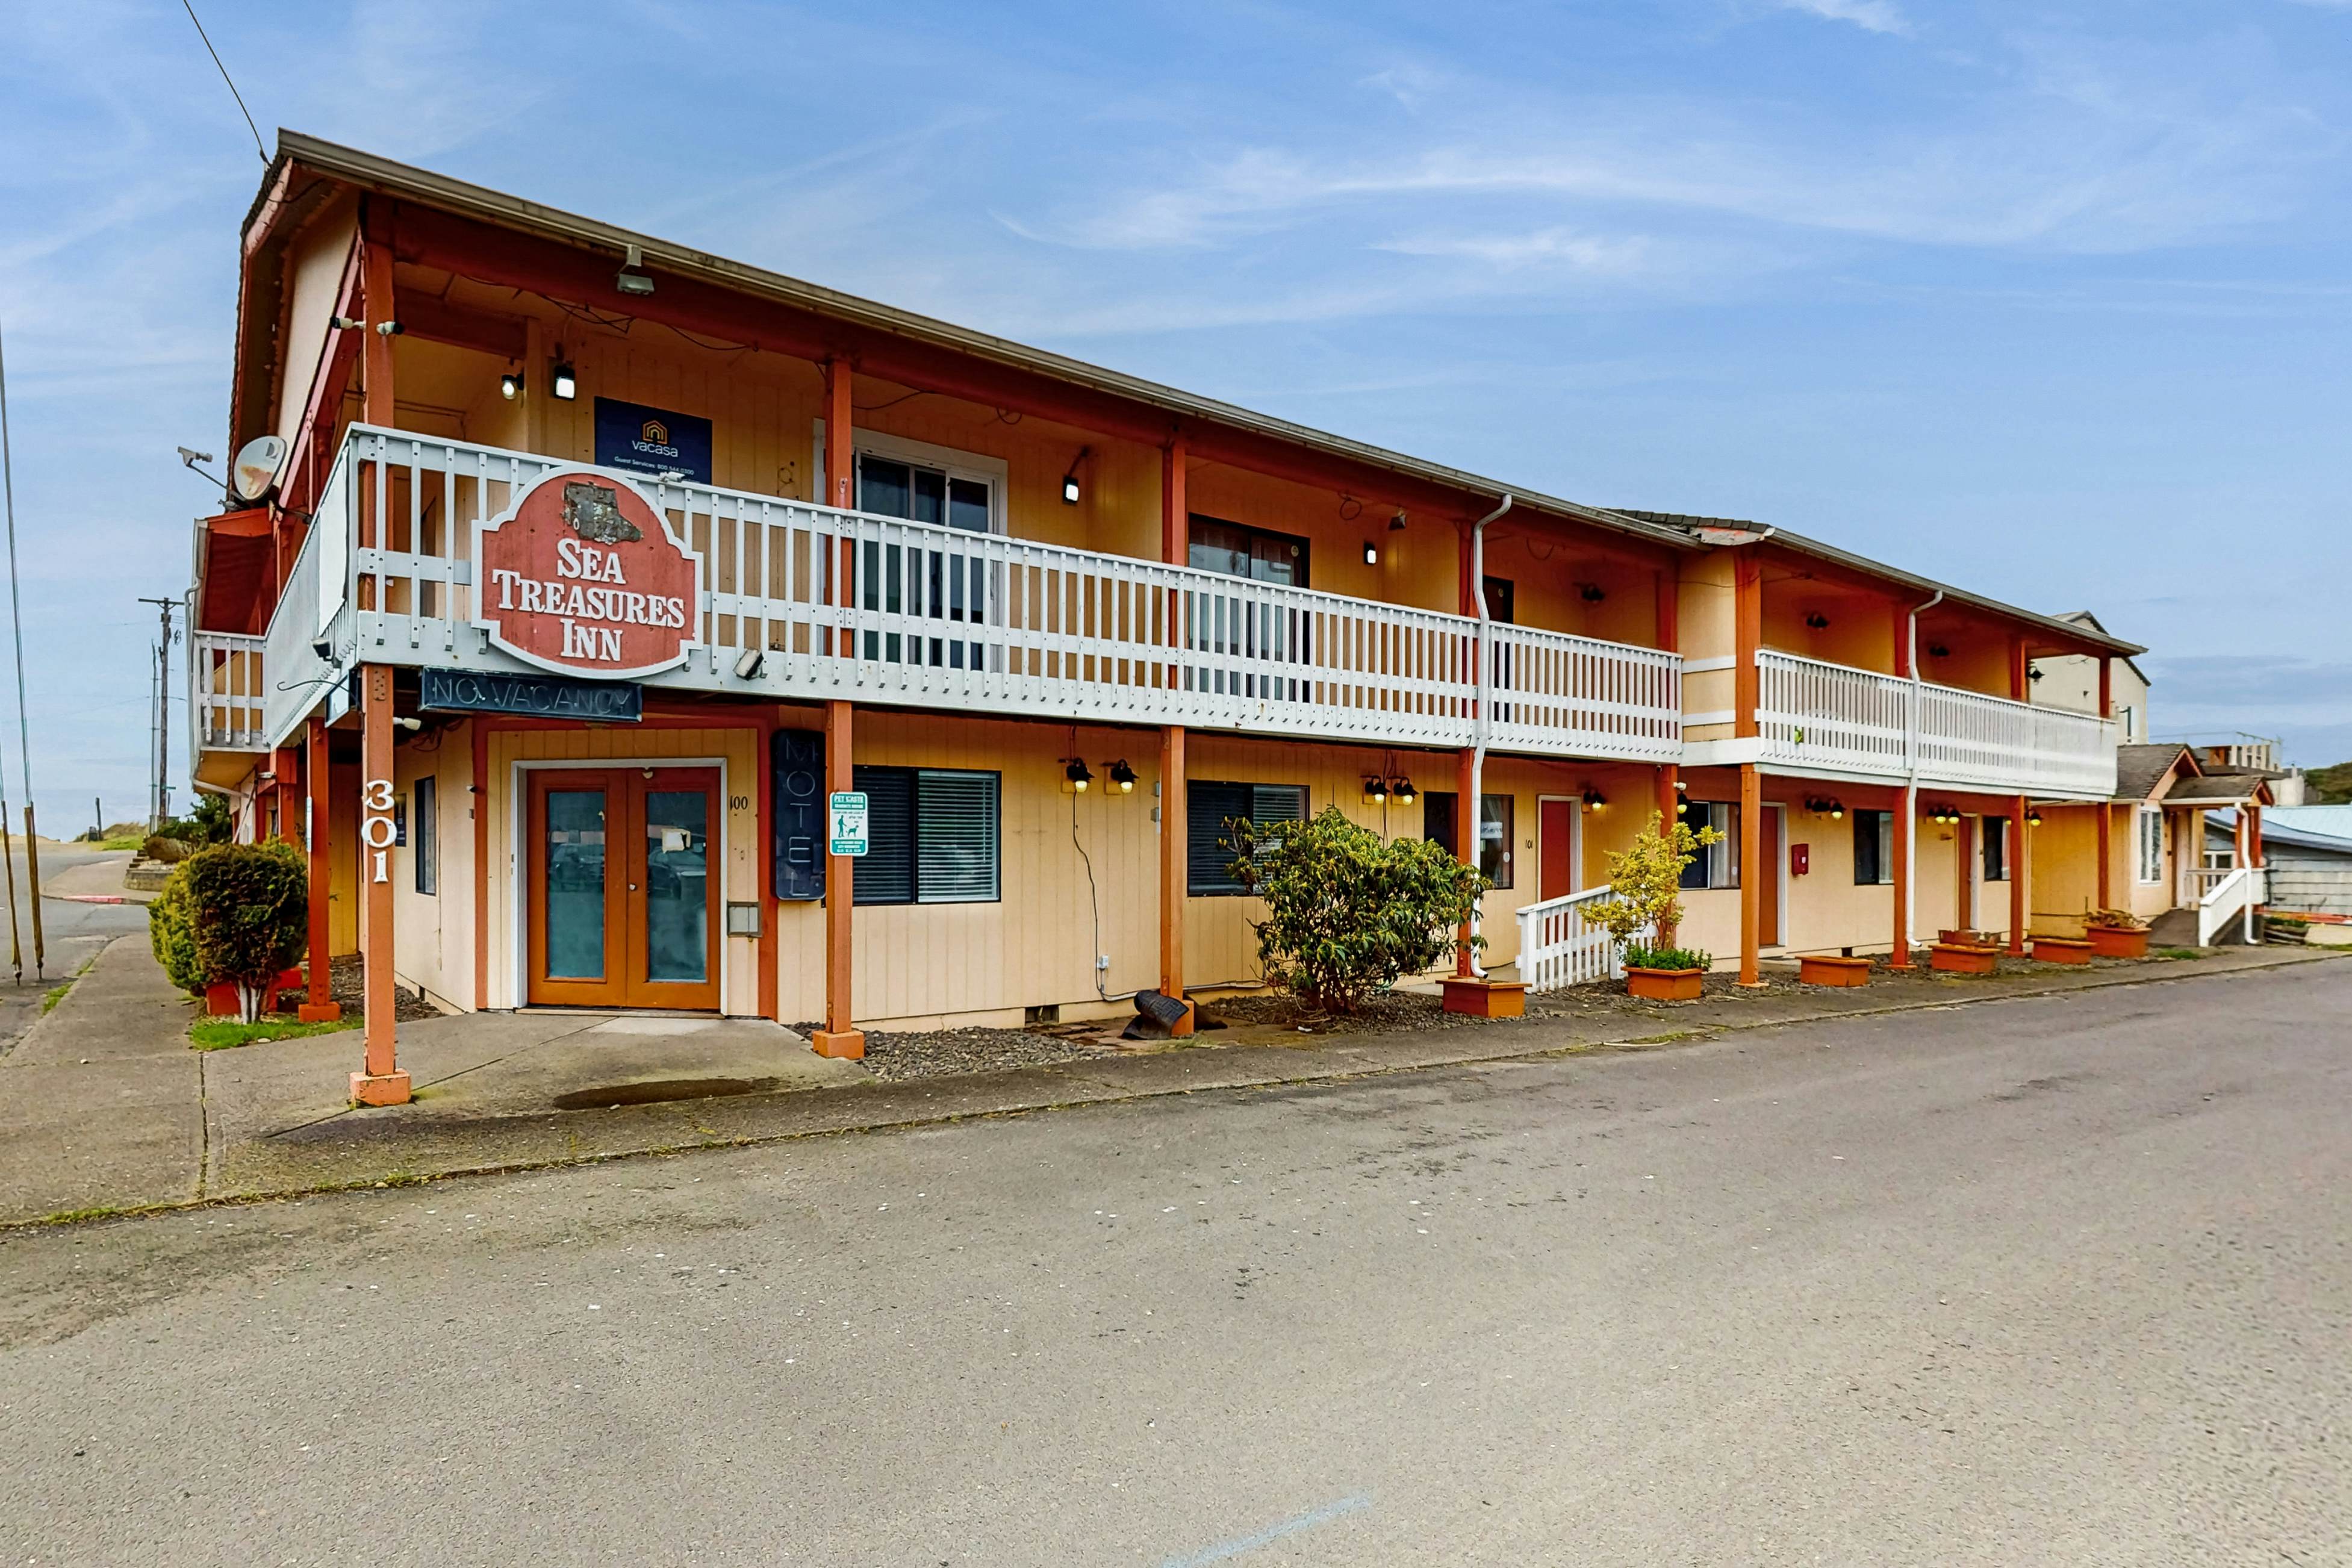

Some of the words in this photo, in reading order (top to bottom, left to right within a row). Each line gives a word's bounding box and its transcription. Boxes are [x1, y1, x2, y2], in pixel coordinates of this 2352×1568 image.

[632, 440, 679, 457] vacasa
[557, 538, 626, 584] SEA
[492, 569, 685, 629] TREASURES
[560, 618, 623, 661] INN
[433, 676, 480, 704] NO
[491, 682, 631, 714] VACANCY
[730, 795, 748, 810] 100
[786, 738, 815, 896] MOTEL
[361, 780, 397, 883] 301
